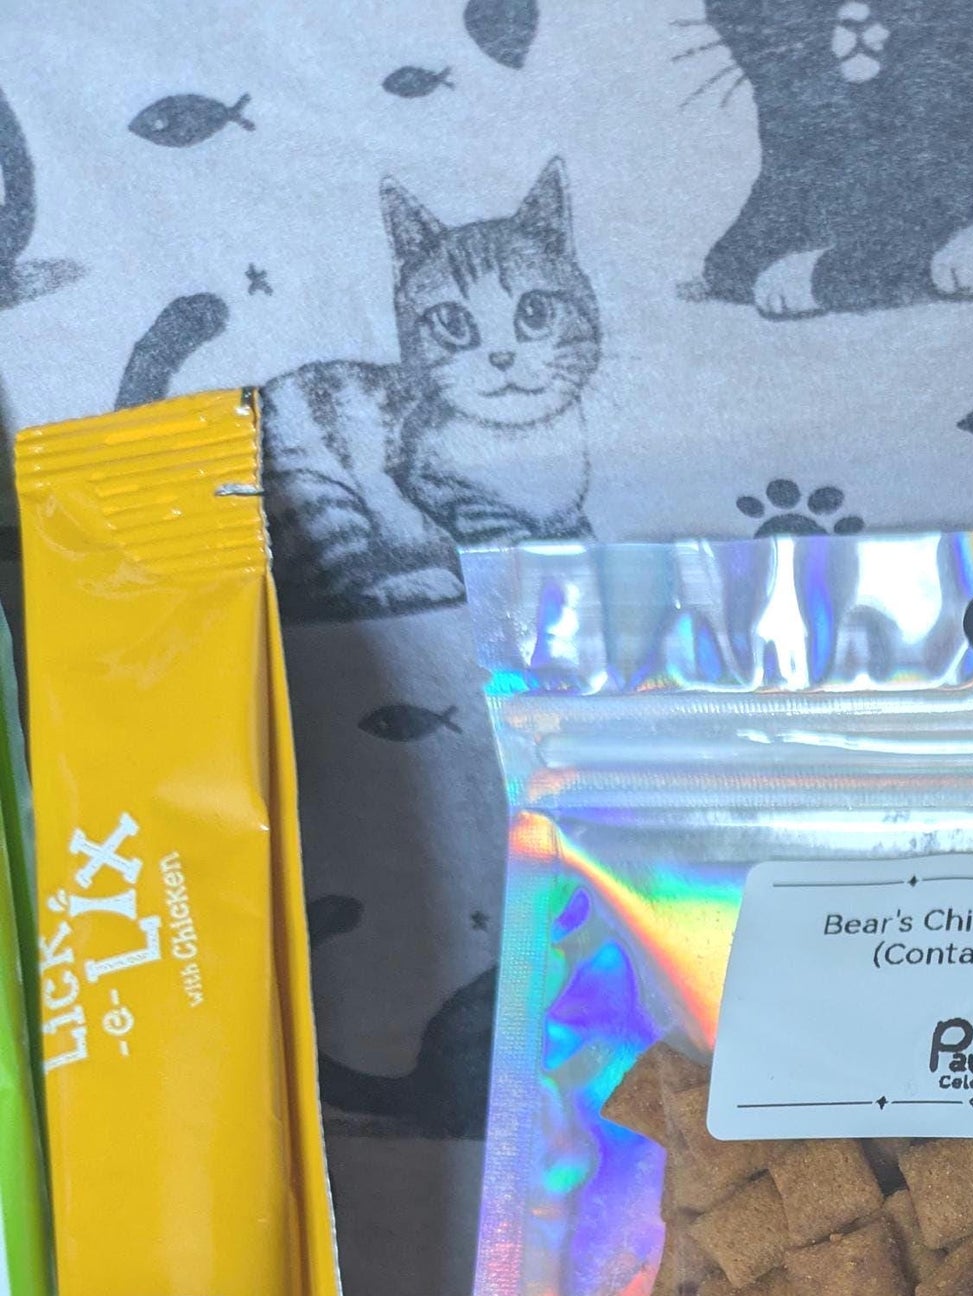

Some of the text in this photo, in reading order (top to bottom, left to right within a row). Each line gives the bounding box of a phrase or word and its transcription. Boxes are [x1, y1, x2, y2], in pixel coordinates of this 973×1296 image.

[160, 851, 204, 1008] with Chicken
[823, 908, 914, 935] Bear's
